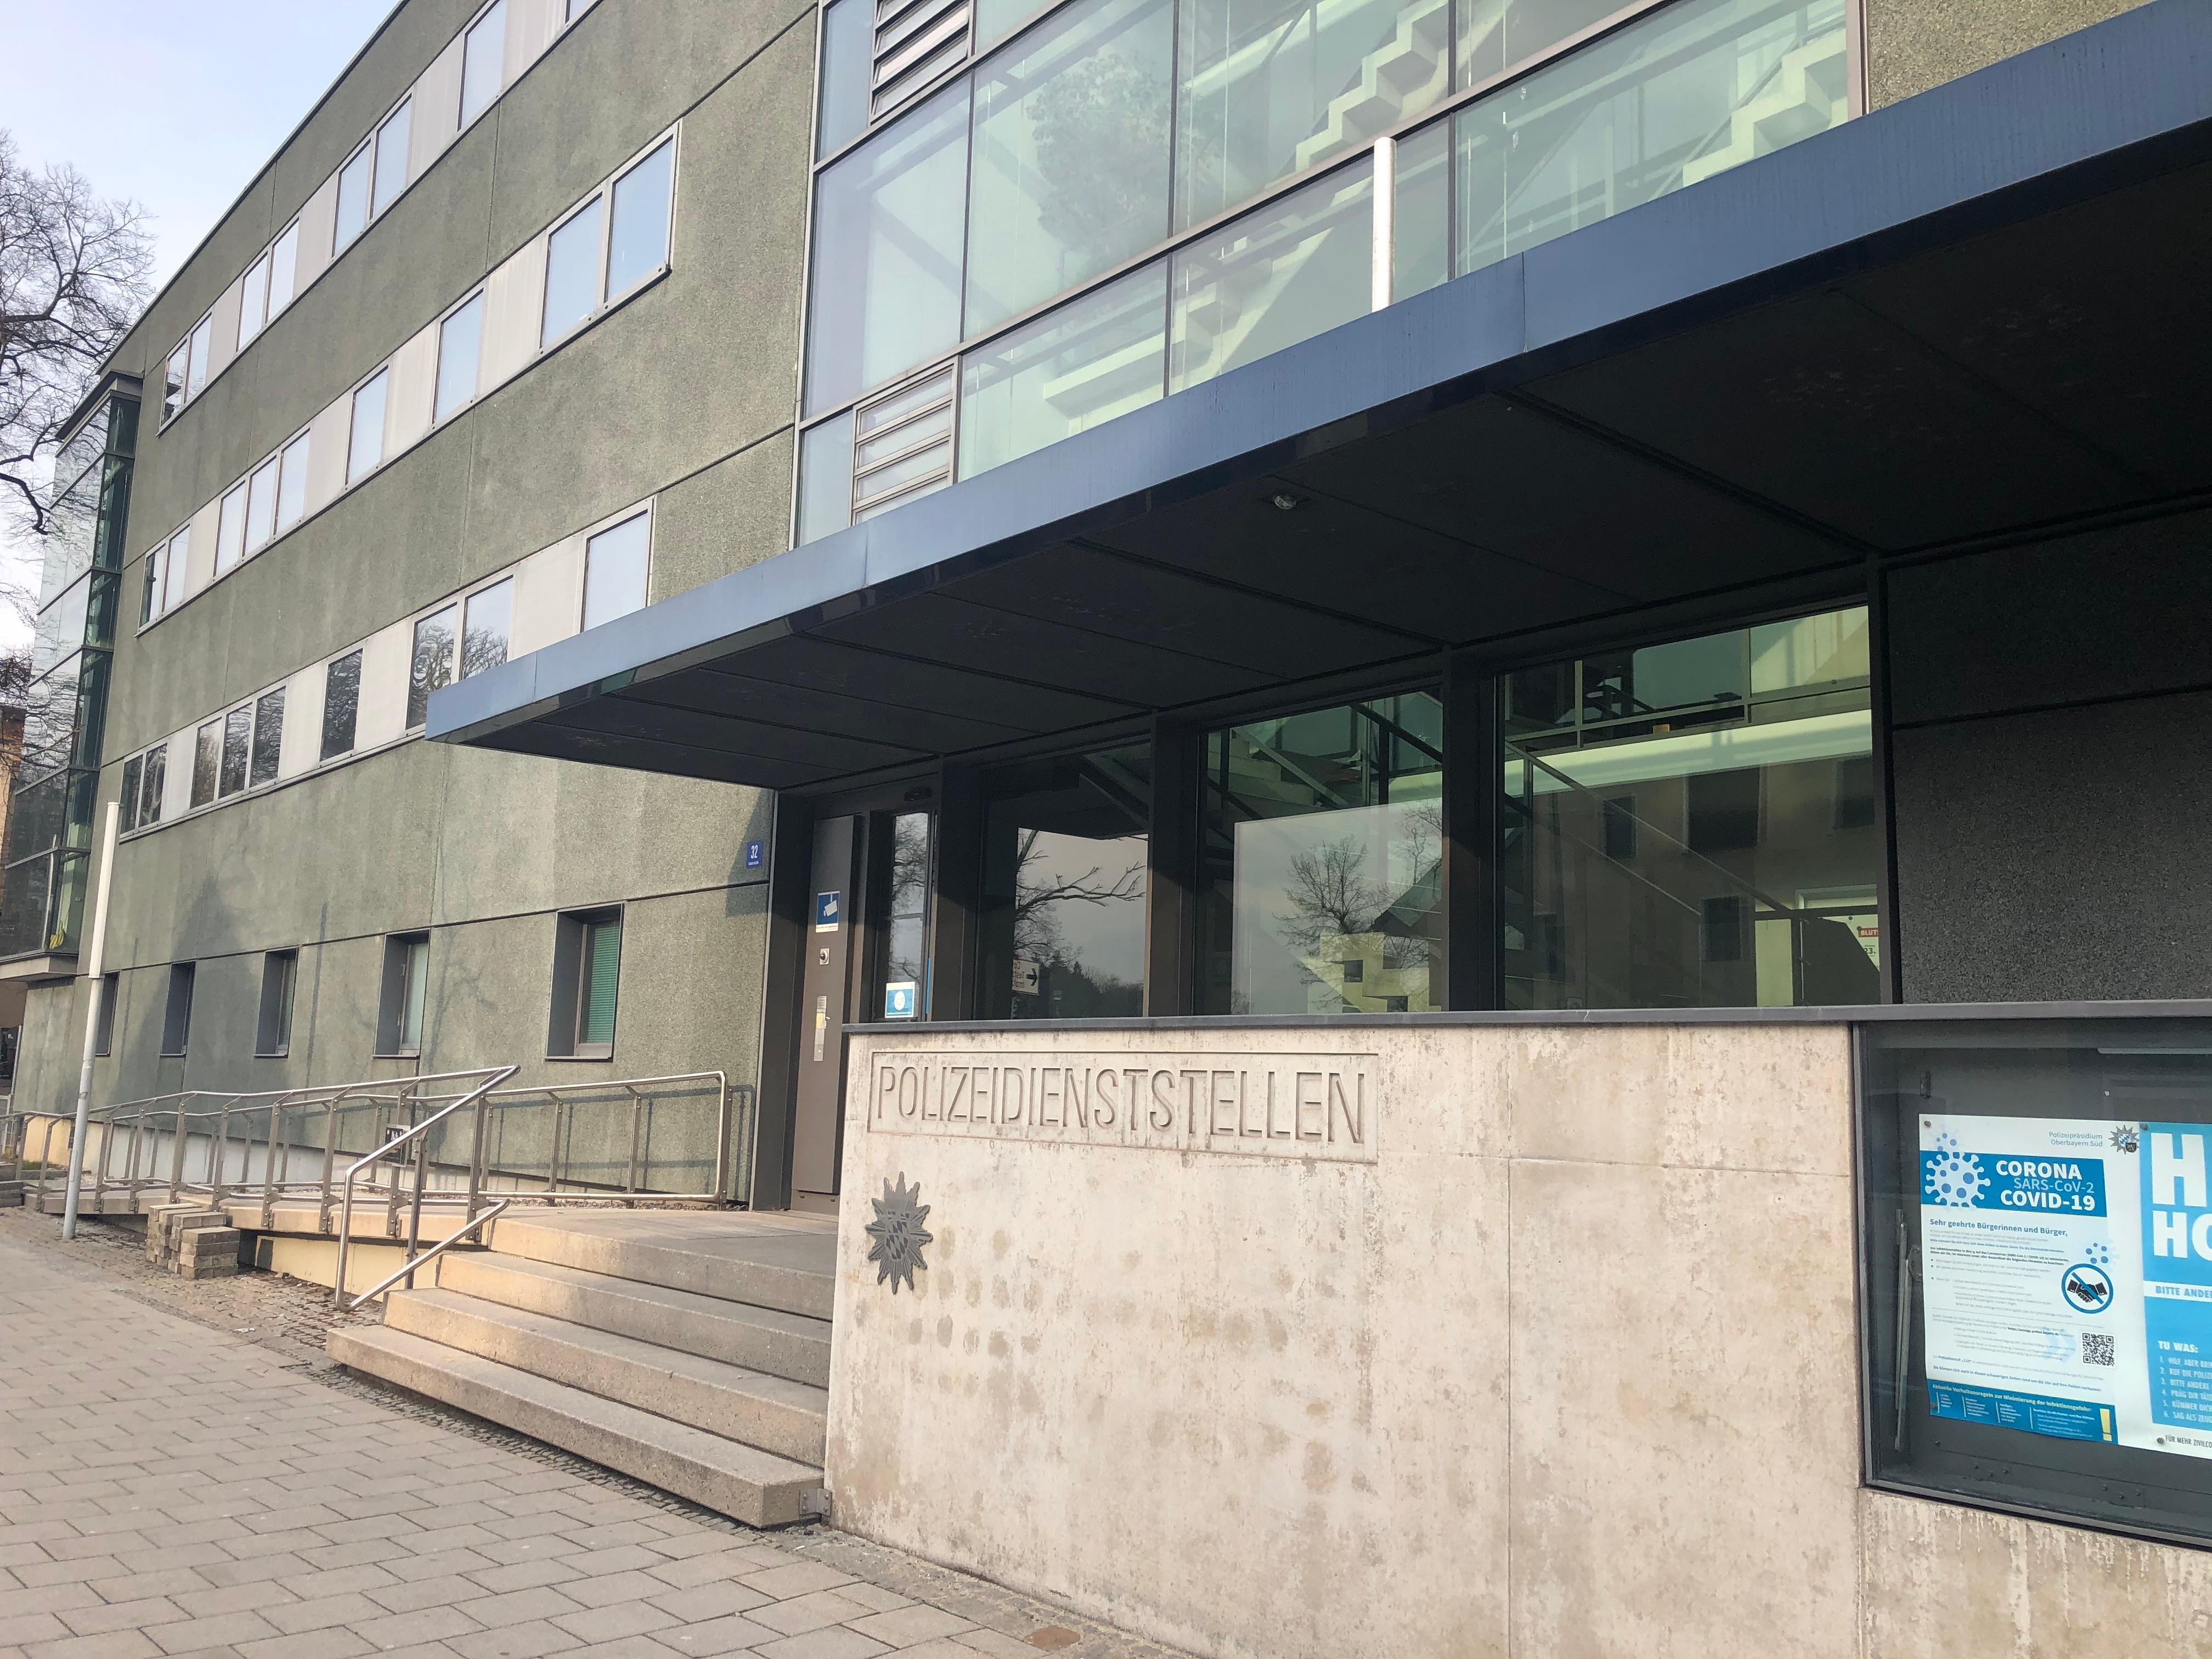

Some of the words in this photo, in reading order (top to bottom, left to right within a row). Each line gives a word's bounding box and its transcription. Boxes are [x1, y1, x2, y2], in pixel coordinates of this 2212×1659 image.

[751, 845, 758, 859] 32
[878, 1066, 1365, 1144] POLIZEIDIENSTSTELLEN
[2049, 1132, 2103, 1140] Polizeipräsidium
[1996, 1160, 2083, 1180] CORONA
[2013, 1177, 2095, 1194] SARS-CoV-2
[2000, 1189, 2096, 1211] COVID-19
[1977, 1222, 2022, 1232] Bürgerinnen
[2040, 1227, 2068, 1237] Bürger,
[2155, 1286, 2180, 1295] BITTE
[2158, 1340, 2170, 1350] TU
[2173, 1342, 2198, 1353] WAS:
[2165, 1434, 2176, 1443] FÜR
[2177, 1437, 2192, 1445] MEHR
